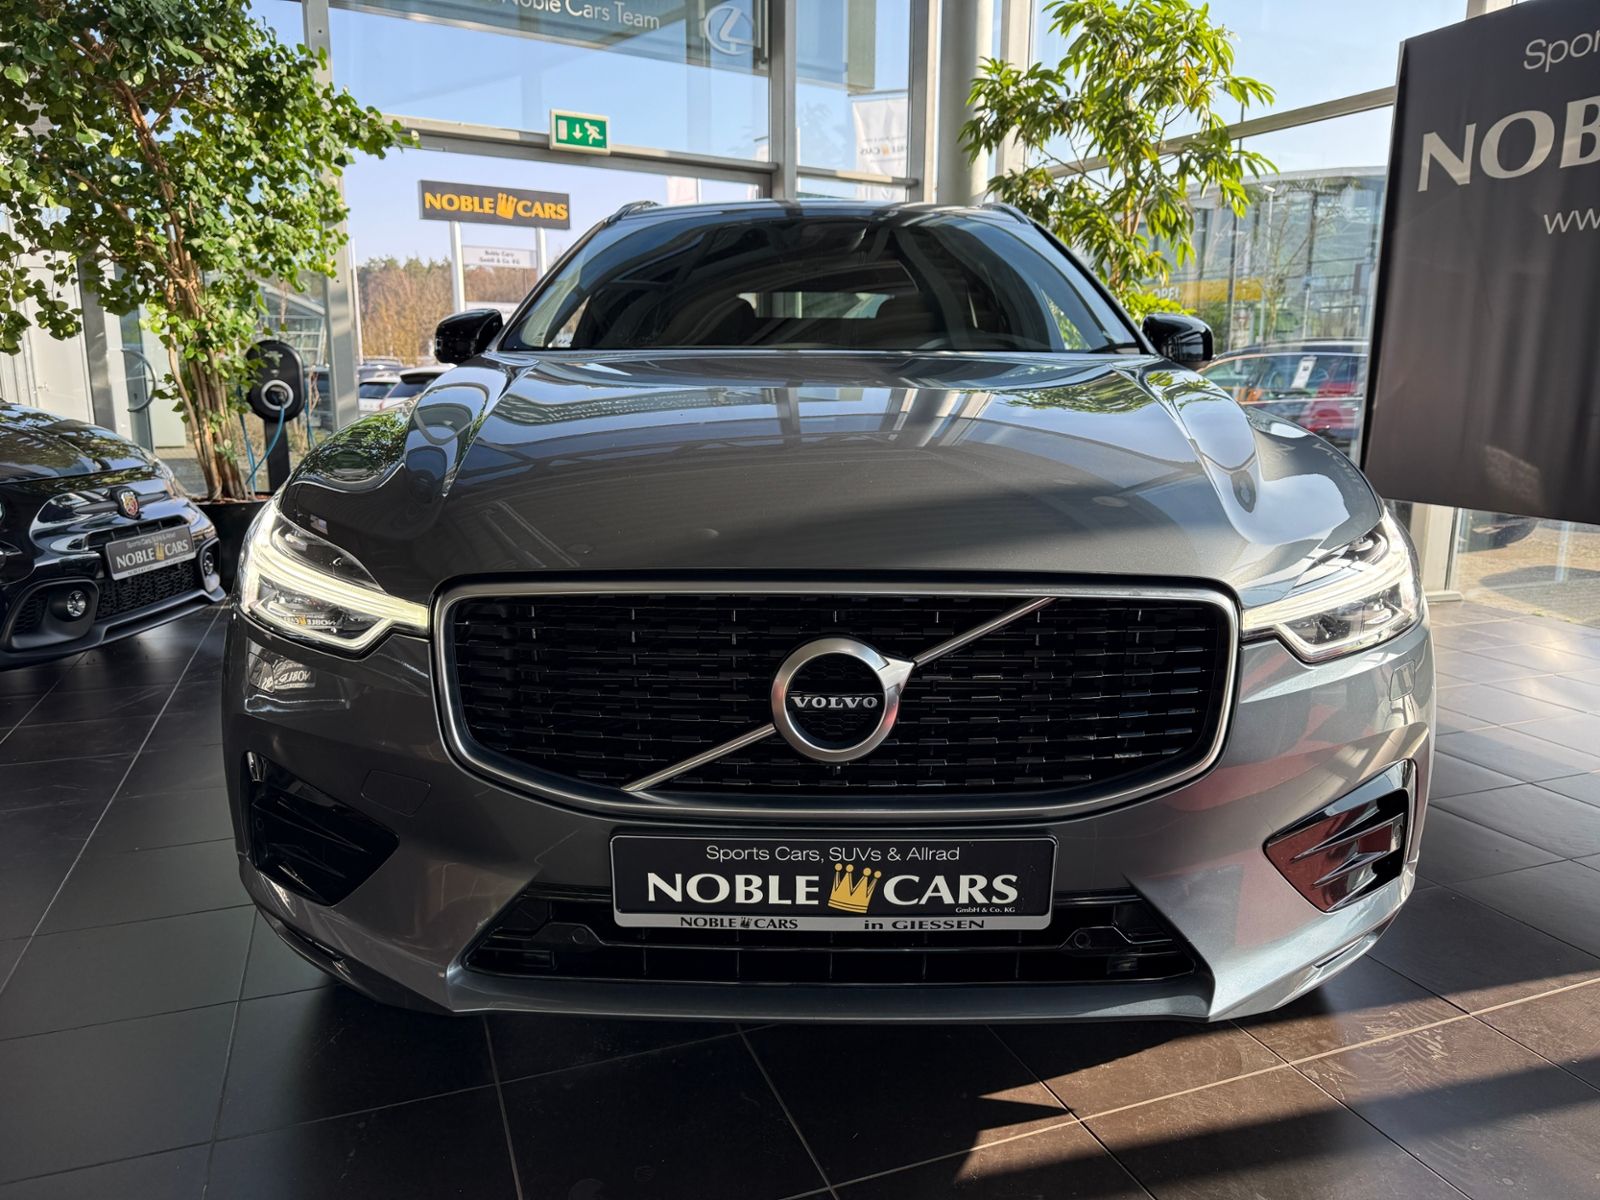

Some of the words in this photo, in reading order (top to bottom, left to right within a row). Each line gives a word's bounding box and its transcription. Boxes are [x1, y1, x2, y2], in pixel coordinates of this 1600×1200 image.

[513, 0, 562, 13] oble
[565, 0, 610, 21] Cars
[614, 1, 660, 29] Team
[1418, 95, 1600, 192] NOB
[424, 192, 495, 214] NOBLE
[516, 200, 568, 221] CARS
[116, 548, 155, 569] NOBLE
[164, 539, 189, 556] CARS
[791, 696, 878, 708] VOLVO
[706, 845, 770, 863] Sports
[775, 846, 824, 863] Cars,
[829, 847, 882, 861] SUVs
[887, 847, 902, 861] &
[906, 846, 960, 861] Allrad
[647, 872, 820, 905] NOBLE
[883, 874, 1018, 905] CARS
[680, 916, 737, 928] NOBLE
[754, 918, 798, 929] CARS
[864, 920, 883, 930] in
[892, 920, 985, 930] GIESSEN
